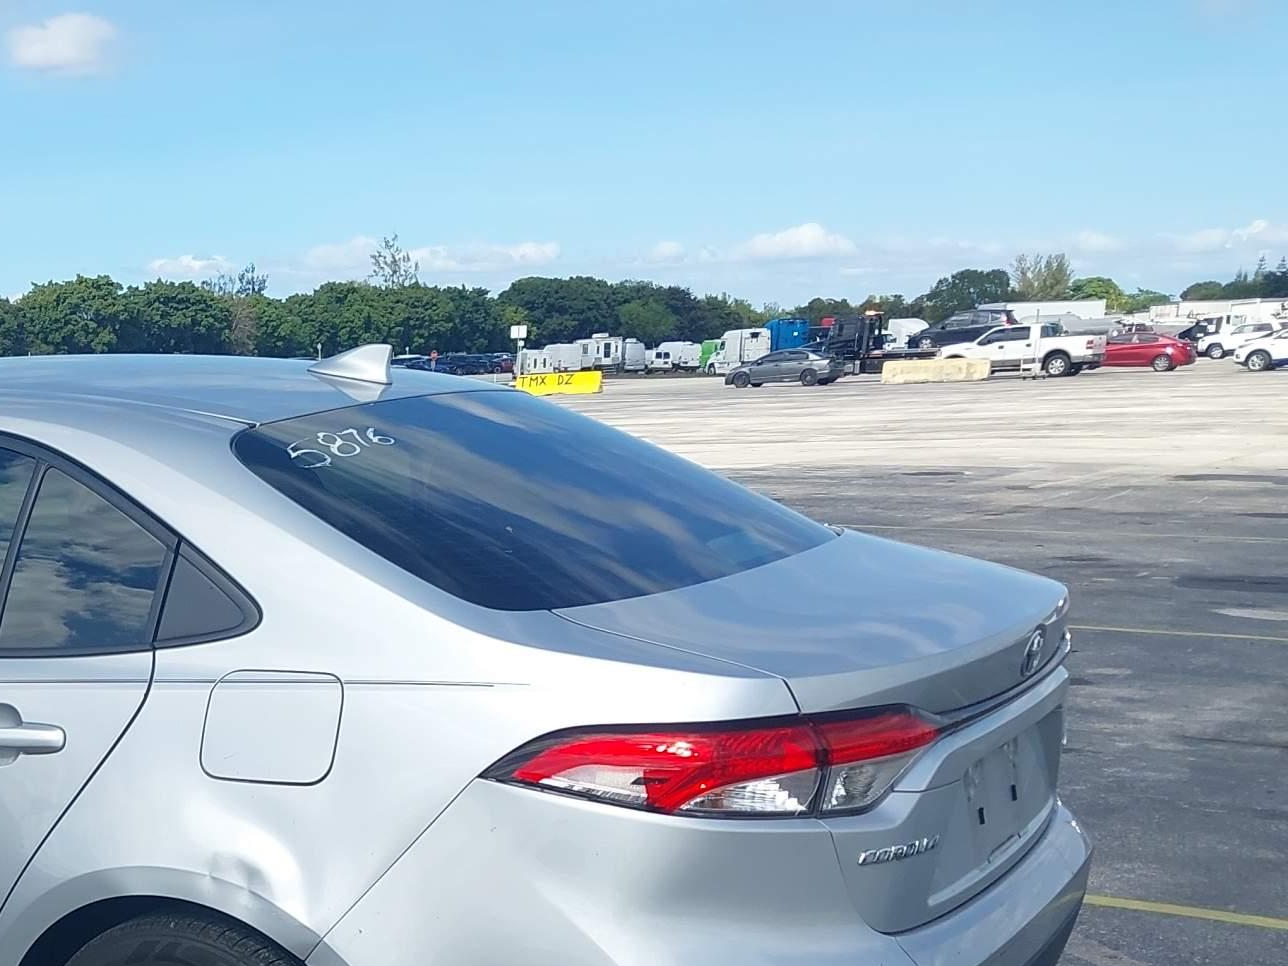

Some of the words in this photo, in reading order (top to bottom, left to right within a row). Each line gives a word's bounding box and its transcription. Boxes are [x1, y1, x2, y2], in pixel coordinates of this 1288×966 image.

[519, 375, 547, 388] TMX
[557, 374, 575, 385] DZ
[286, 427, 395, 469] 5876
